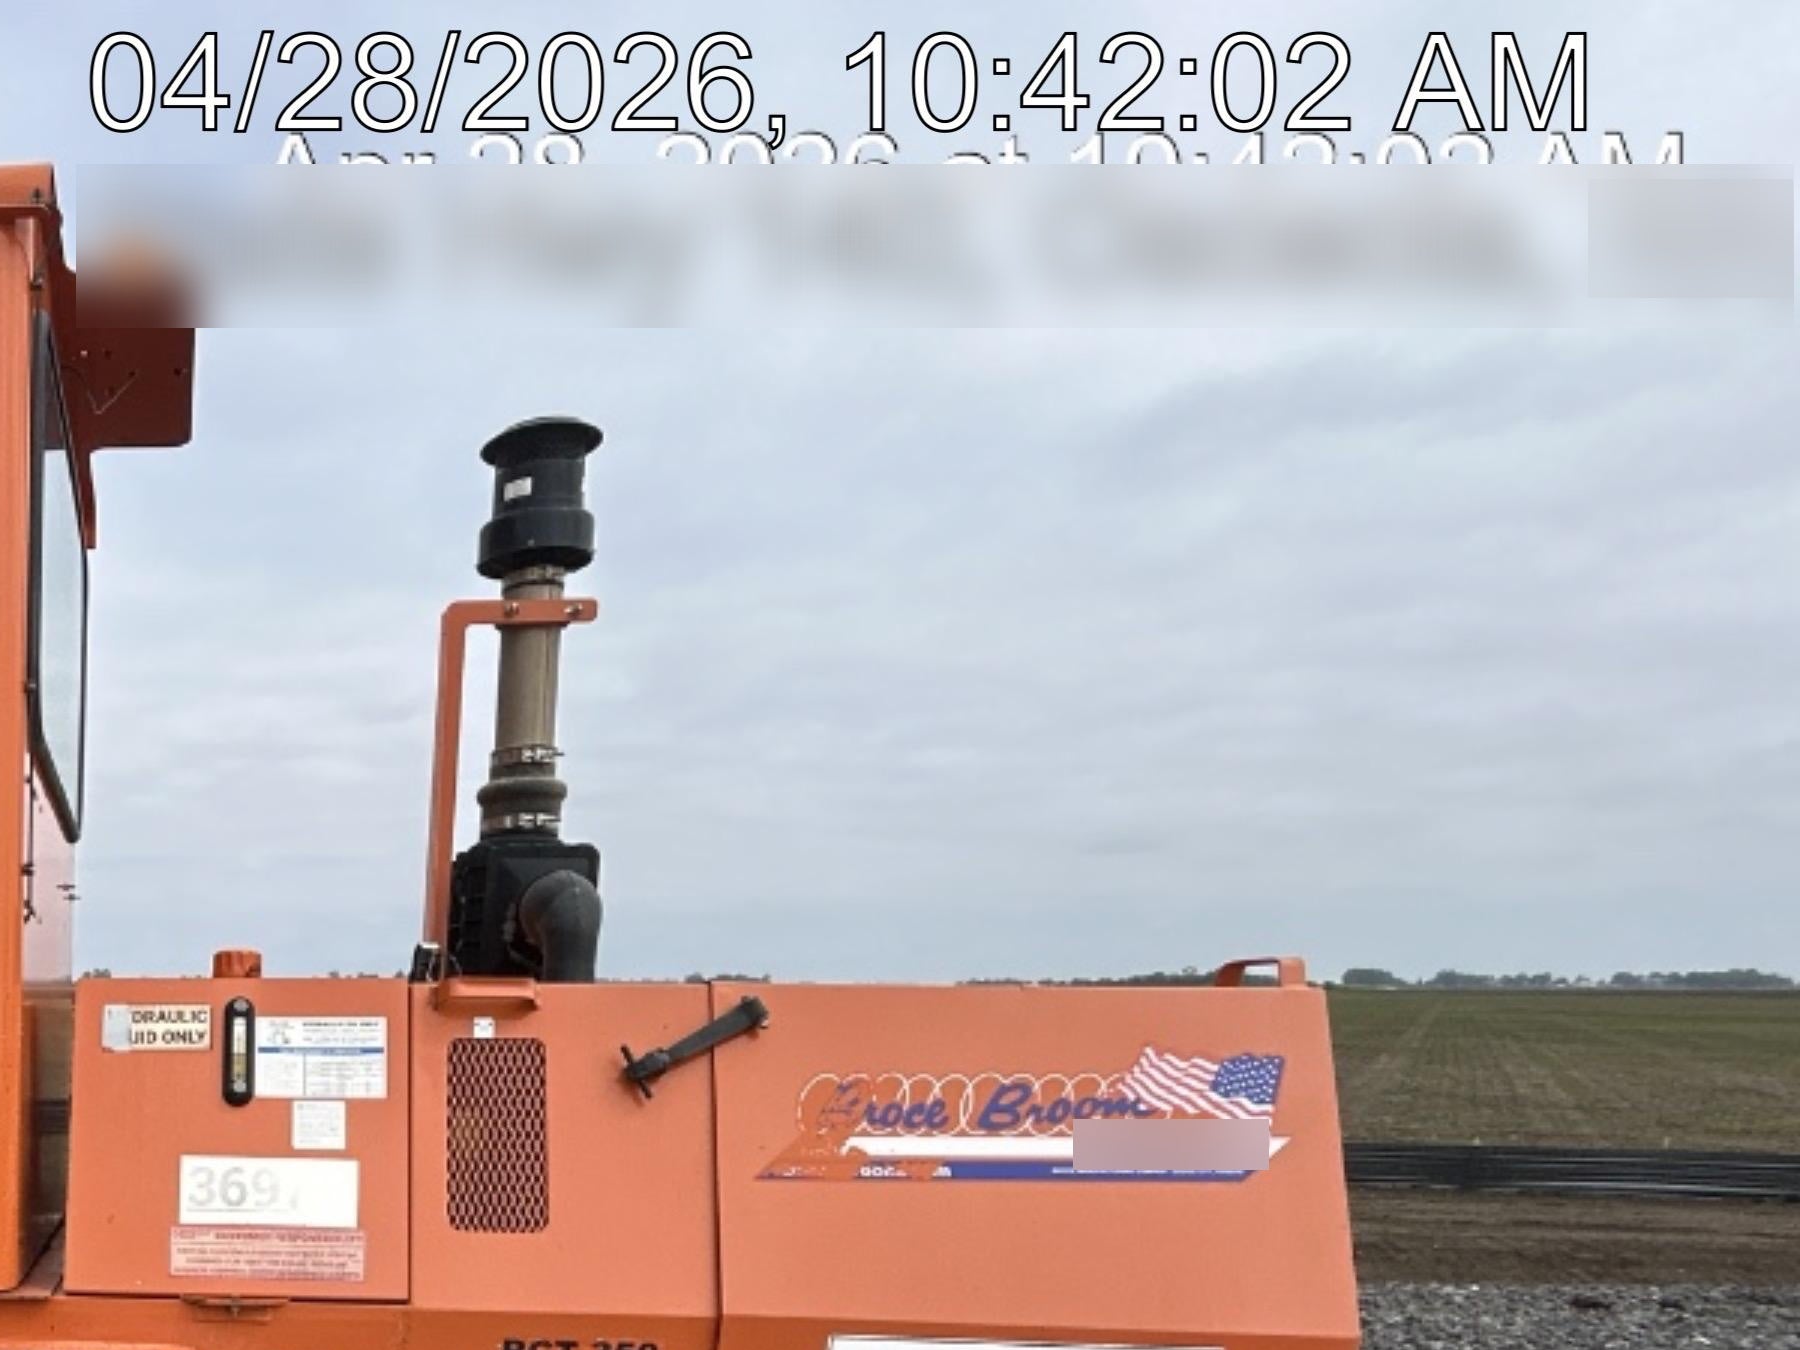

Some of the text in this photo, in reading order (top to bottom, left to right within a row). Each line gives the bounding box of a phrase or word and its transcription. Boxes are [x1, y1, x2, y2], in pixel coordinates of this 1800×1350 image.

[108, 1009, 208, 1024] DRAULIC
[161, 1029, 207, 1045] ONLY
[976, 1082, 1154, 1131] Broom
